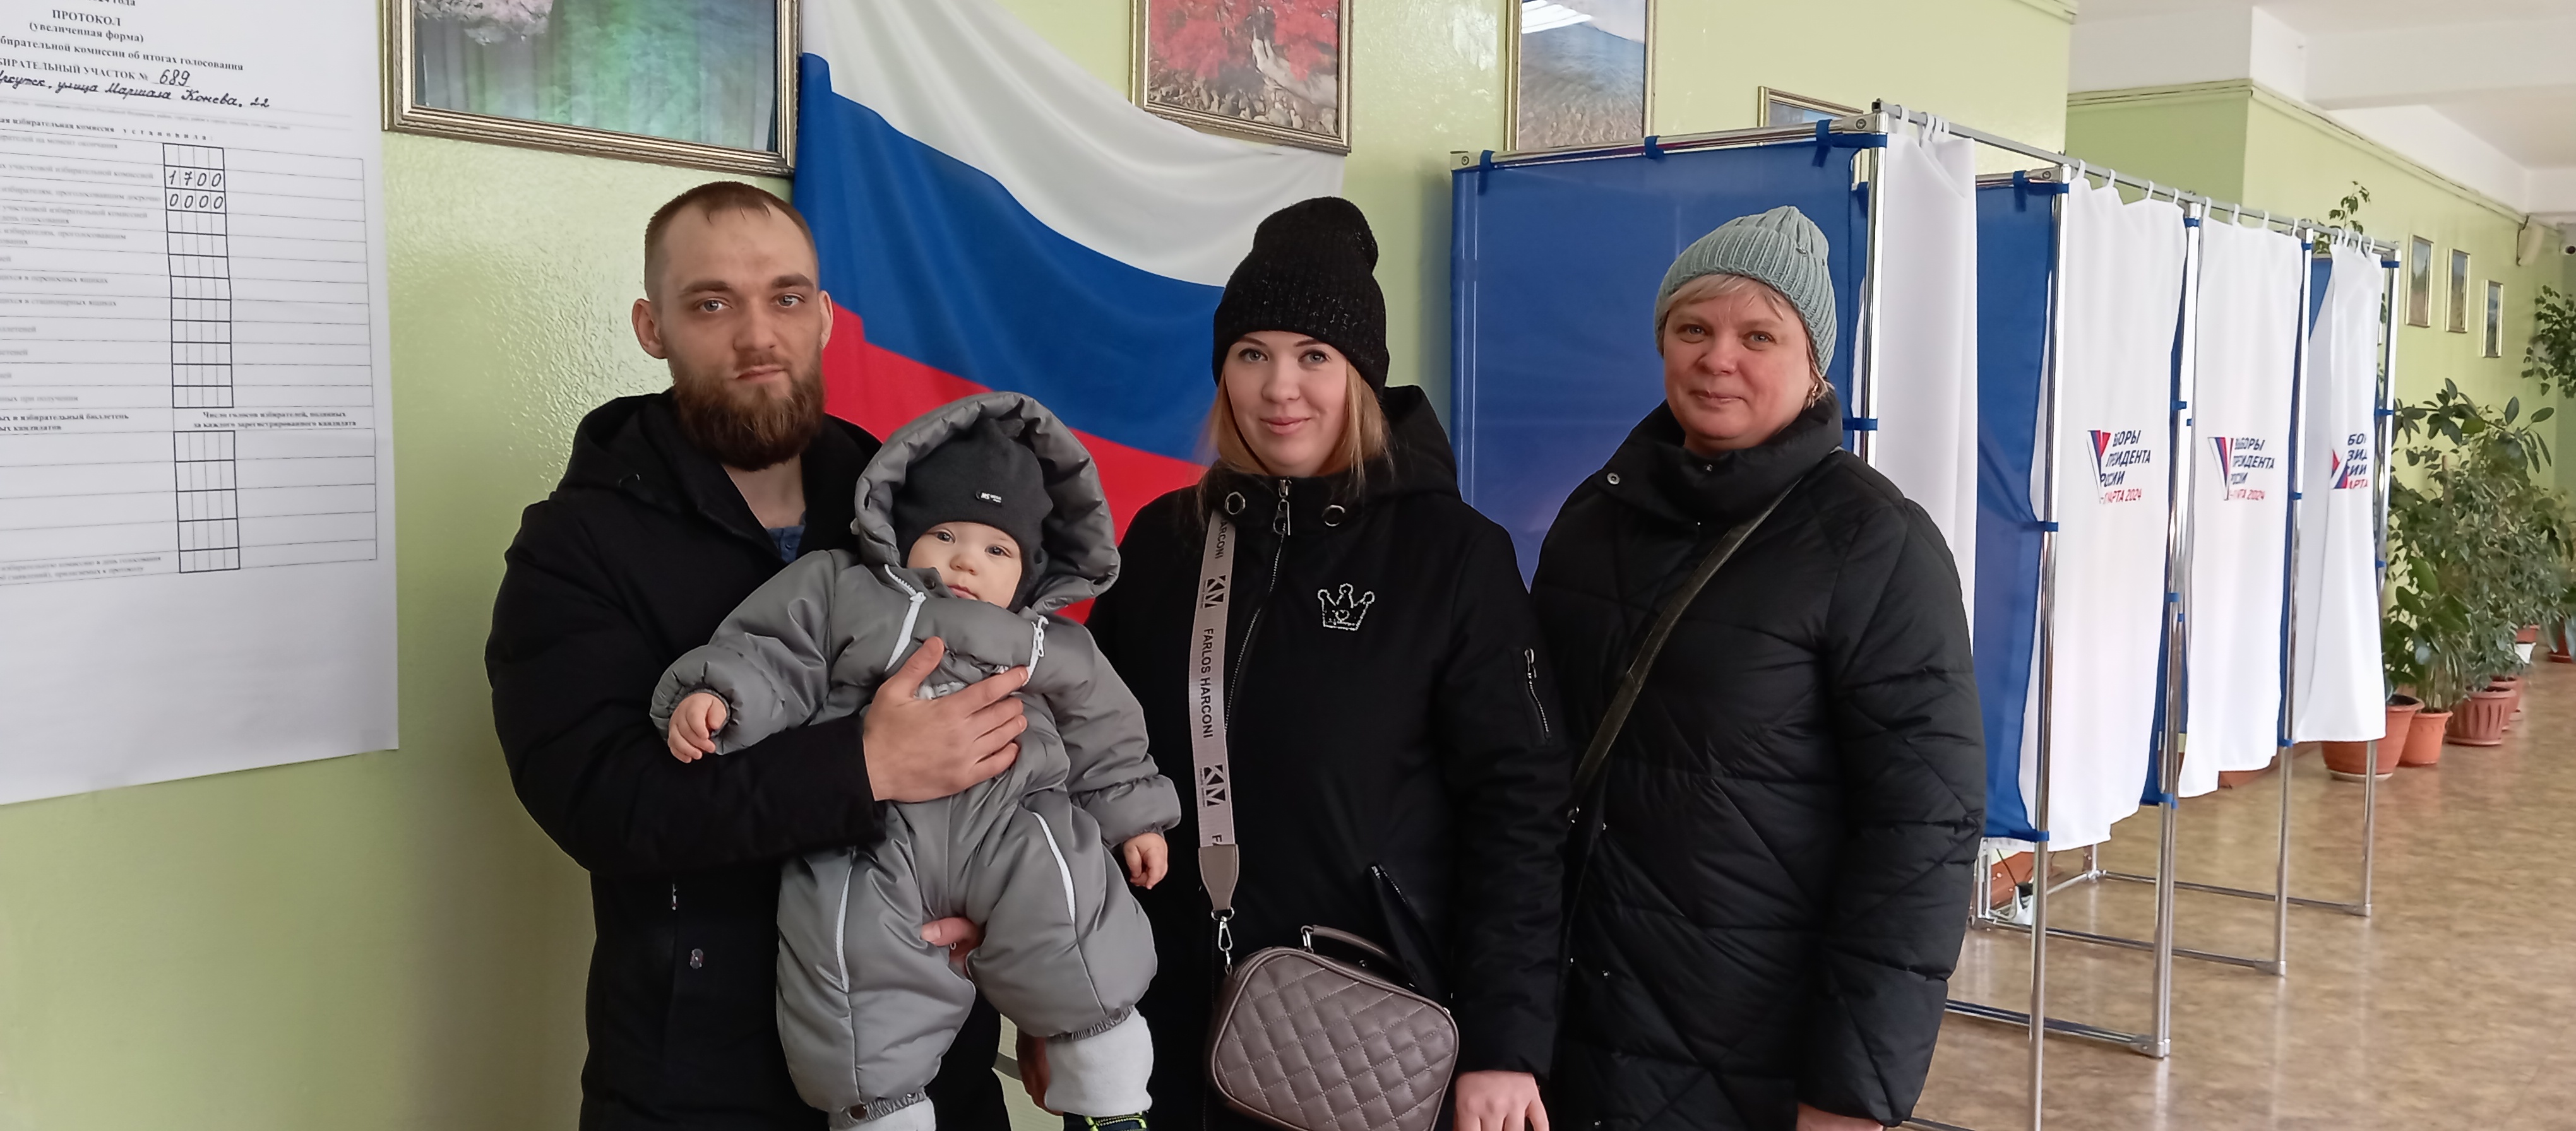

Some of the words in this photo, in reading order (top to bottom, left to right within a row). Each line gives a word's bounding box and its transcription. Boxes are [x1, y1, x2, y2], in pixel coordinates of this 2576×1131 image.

[52, 9, 121, 26] ПРОТОКОЛ
[30, 21, 103, 38] (увеличенная
[105, 30, 144, 42] форма)
[74, 45, 126, 58] комиссии
[128, 51, 140, 59] об
[143, 54, 177, 64] итогах
[181, 57, 243, 71] голосования
[83, 66, 135, 80] УЧАСТОК
[160, 69, 190, 86] 689
[55, 81, 98, 93] улица
[105, 83, 171, 100] Маршала
[250, 97, 270, 108] 22
[1201, 628, 1213, 674] FARLOS
[1200, 677, 1213, 738] HARCONI
